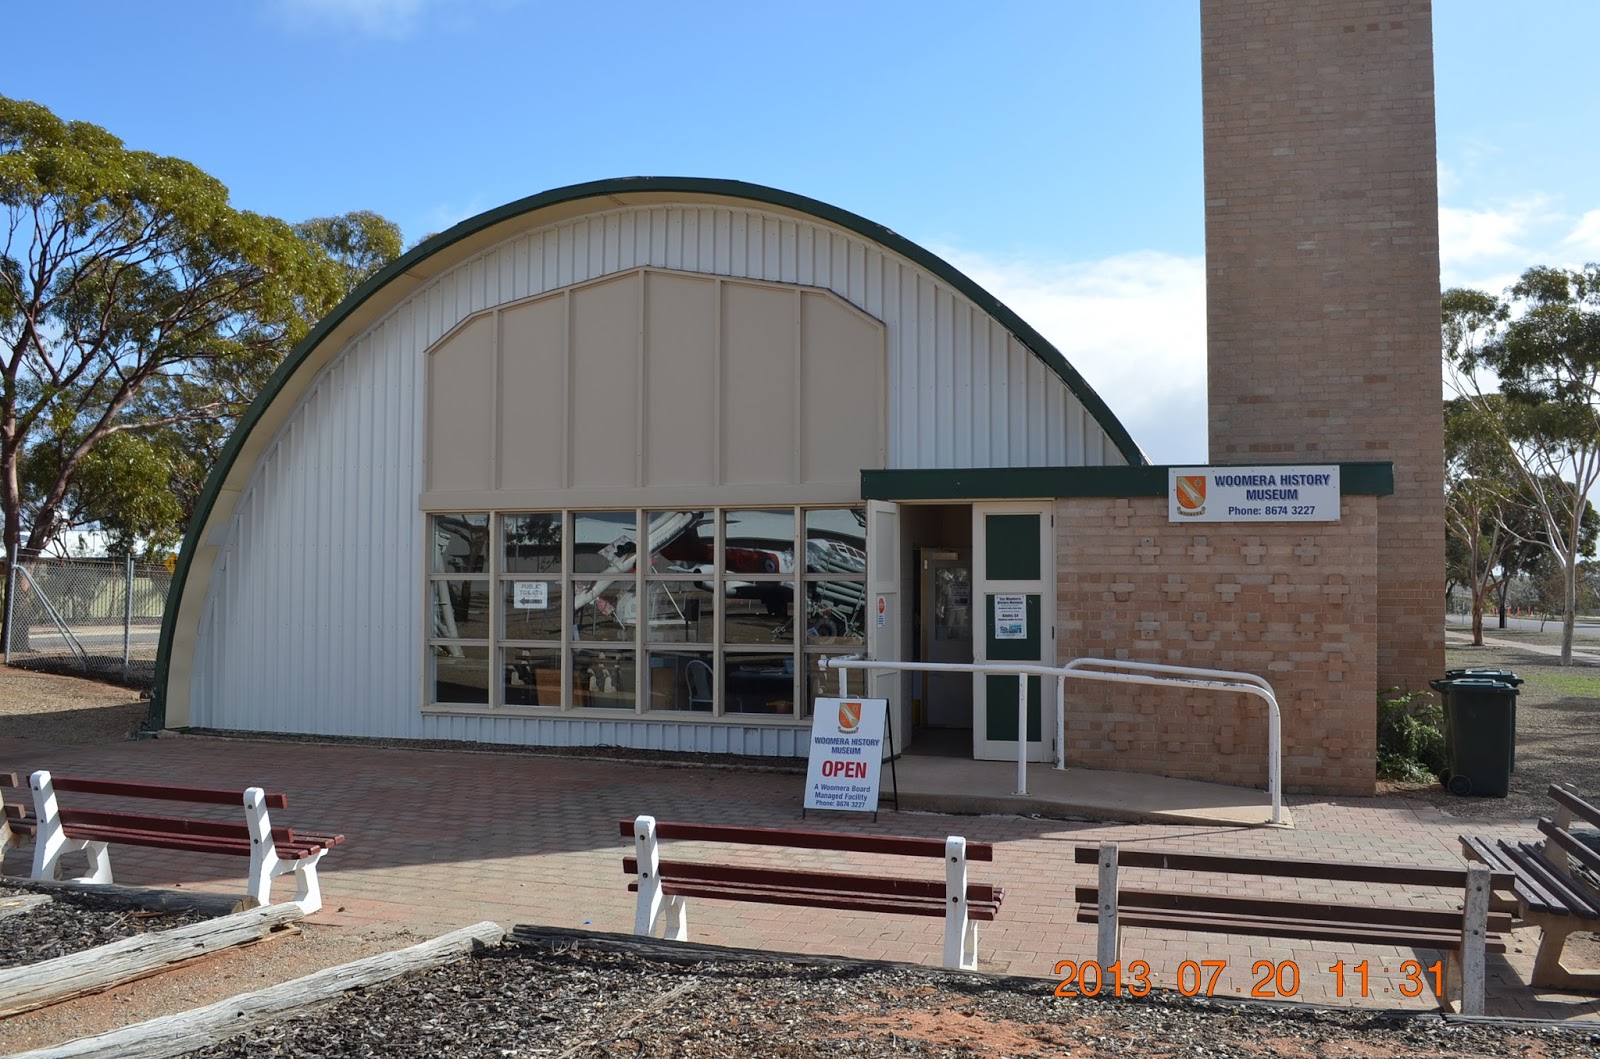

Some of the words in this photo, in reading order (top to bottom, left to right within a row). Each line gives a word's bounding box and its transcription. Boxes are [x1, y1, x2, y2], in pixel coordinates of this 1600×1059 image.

[1214, 474, 1276, 487] WOOMERA
[1280, 473, 1331, 486] HISTORY
[1246, 488, 1299, 501] MUSEUM
[1228, 506, 1262, 515] Phone:
[1265, 506, 1288, 515] 8674
[1291, 506, 1316, 515] 3227
[814, 736, 850, 745] WOOMERA
[851, 738, 880, 747] HISTORY
[831, 746, 861, 755] MUSEUM
[822, 760, 868, 779] OPEN
[820, 783, 850, 791] Woomera
[851, 785, 871, 793] Board
[814, 792, 843, 800] Managed
[844, 793, 868, 802] Facility
